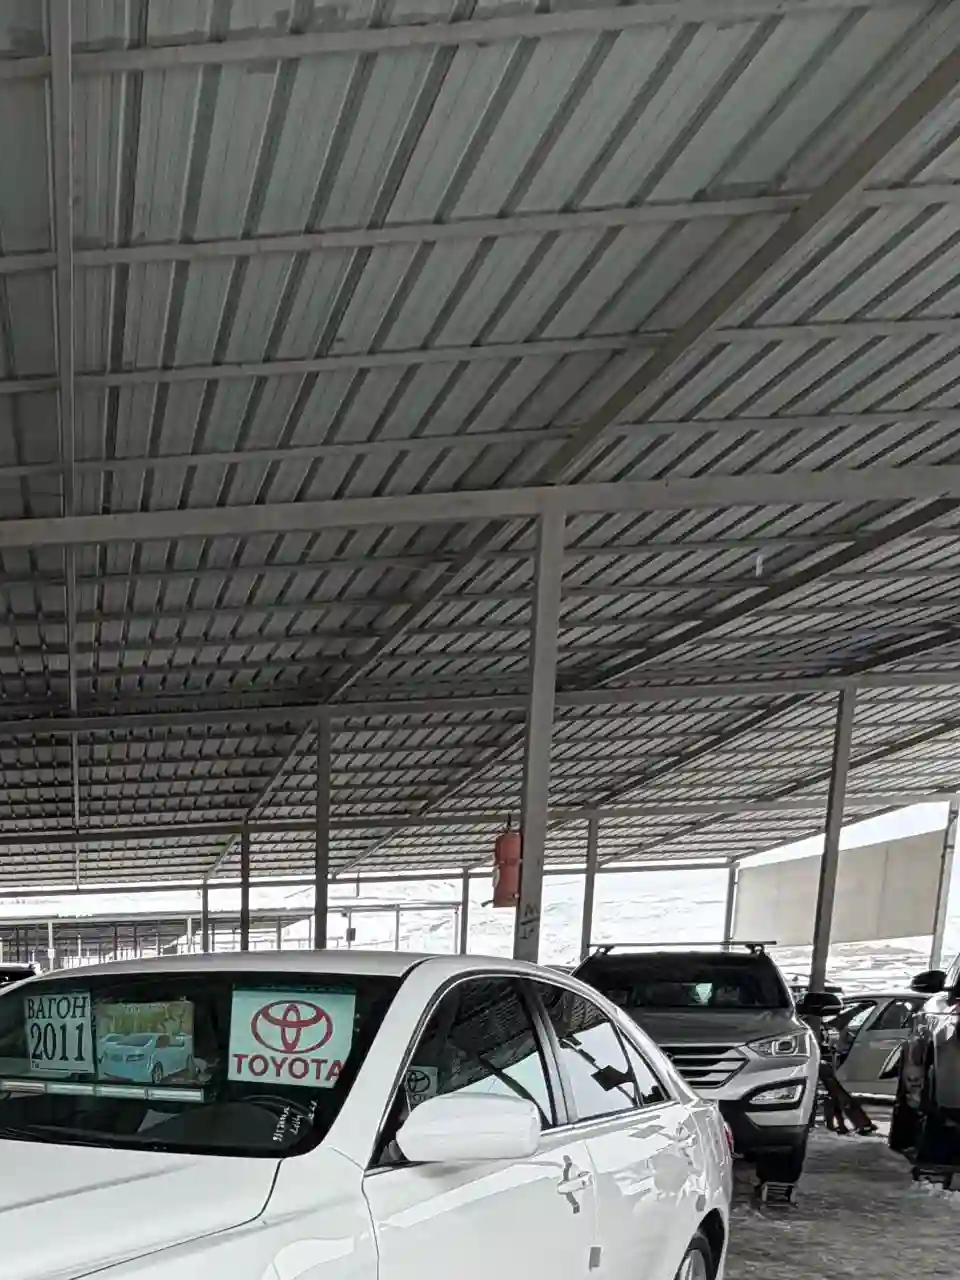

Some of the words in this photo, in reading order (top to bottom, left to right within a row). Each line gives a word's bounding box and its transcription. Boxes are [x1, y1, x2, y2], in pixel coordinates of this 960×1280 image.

[28, 996, 88, 1020] ВАГОН
[30, 1022, 86, 1062] 2011
[232, 1053, 345, 1081] TOYOTA
